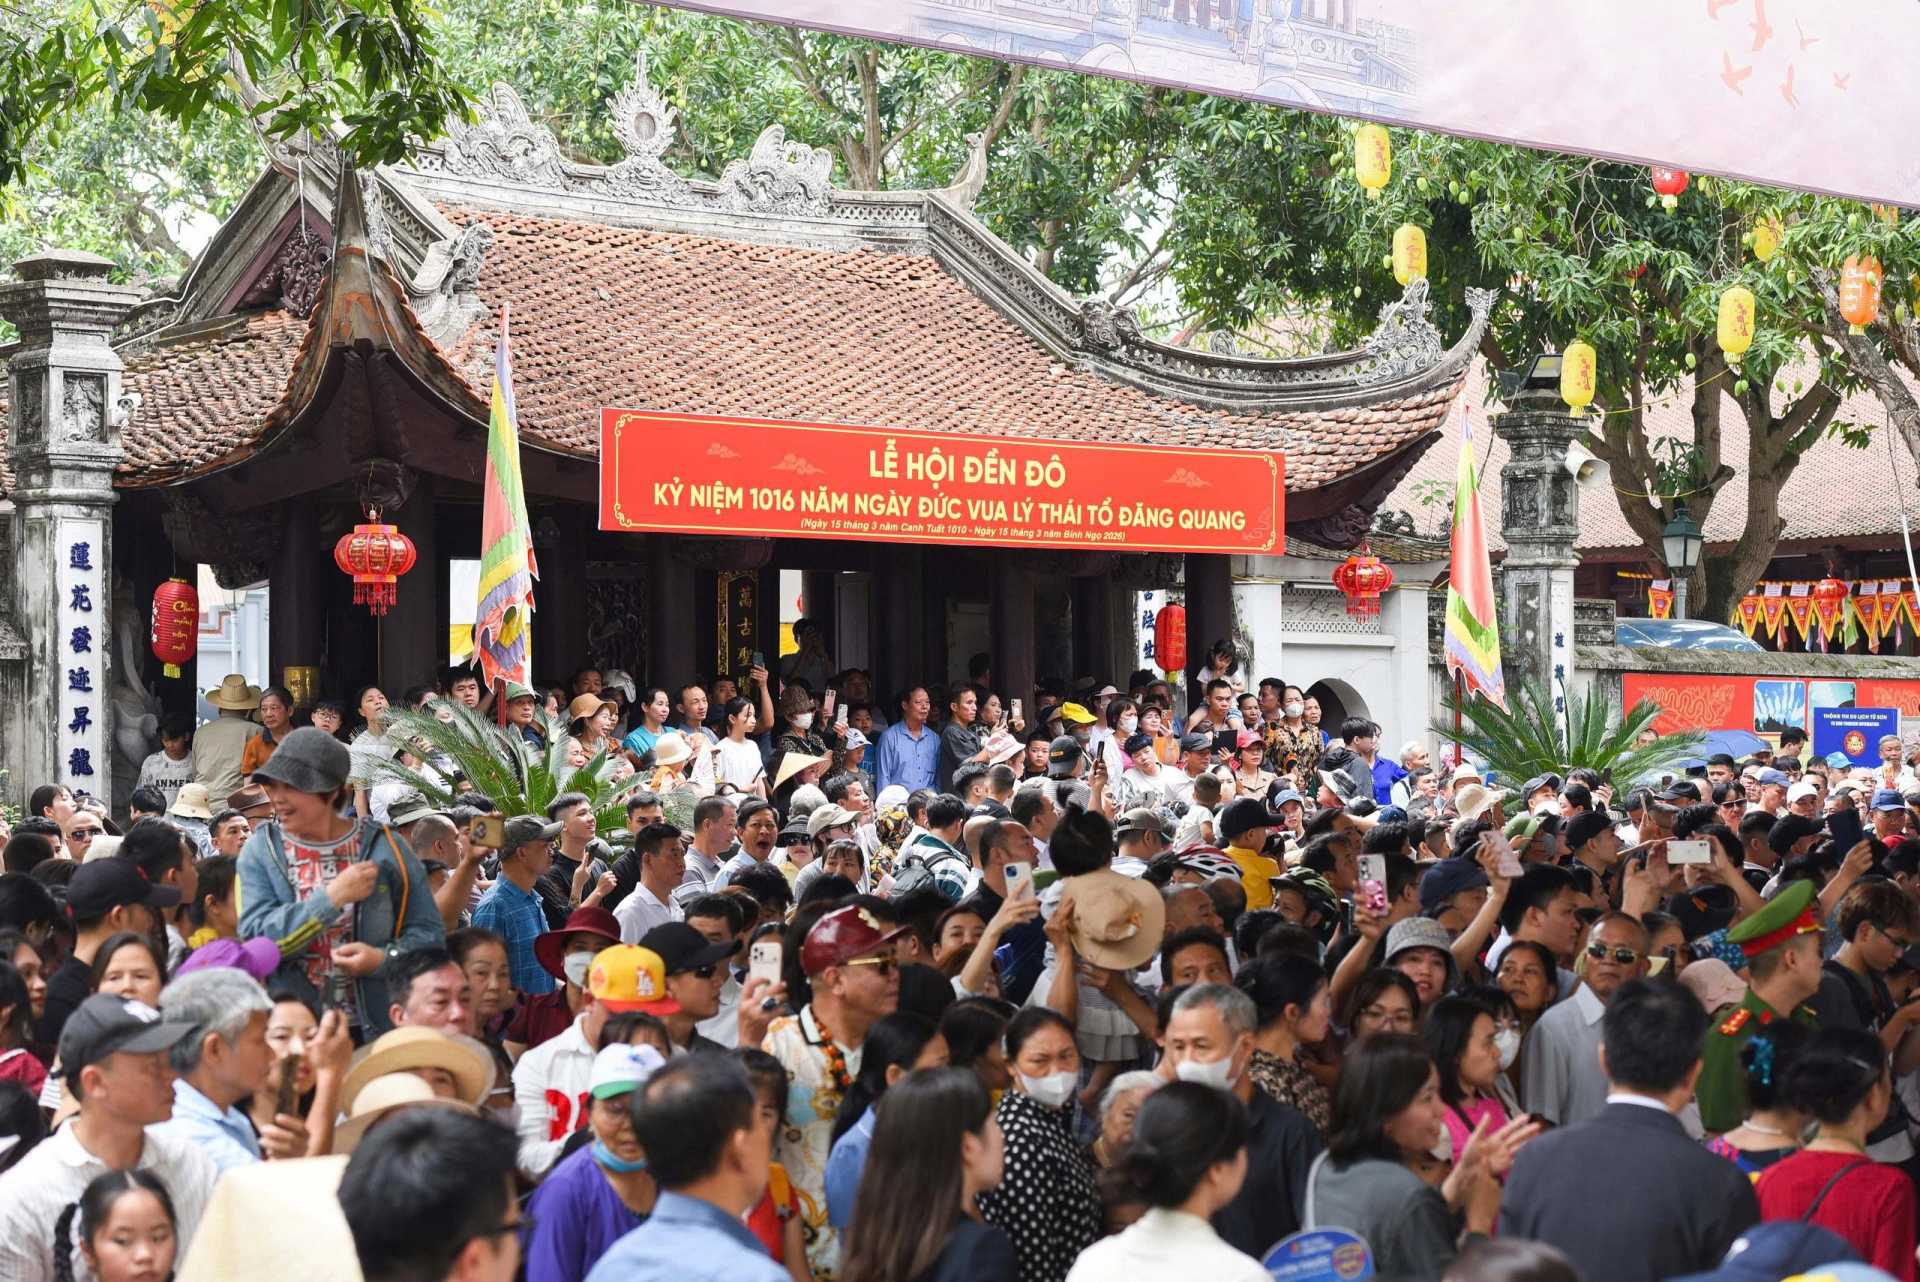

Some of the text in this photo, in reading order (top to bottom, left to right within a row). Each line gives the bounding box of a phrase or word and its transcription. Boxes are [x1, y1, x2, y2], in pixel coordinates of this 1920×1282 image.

[870, 439, 1065, 489] LỄ HỘI ĐỀN ĐÔ
[655, 477, 1246, 531] KỶ NIỆM 1016 NĂM NGÀY ĐỨC VUA LÝ THÁI TỔ ĐĂNG QUANG
[800, 518, 829, 530] (Ngày
[831, 519, 842, 529] 15
[843, 520, 870, 532] tháng
[871, 521, 878, 530] 3
[879, 522, 899, 531] năm
[900, 522, 924, 532] Canh
[926, 523, 945, 534] Tuất
[947, 525, 967, 534] 1010
[974, 526, 997, 538] Ngày
[999, 527, 1009, 536] 15
[1010, 527, 1035, 540] tháng
[1036, 529, 1042, 538] 3
[1043, 530, 1062, 538] năm
[1063, 530, 1083, 539] Bính
[1084, 530, 1102, 541] Ngọ
[1103, 531, 1126, 542] 2026)
[69, 542, 94, 802] 蓮花發迹昇龍
